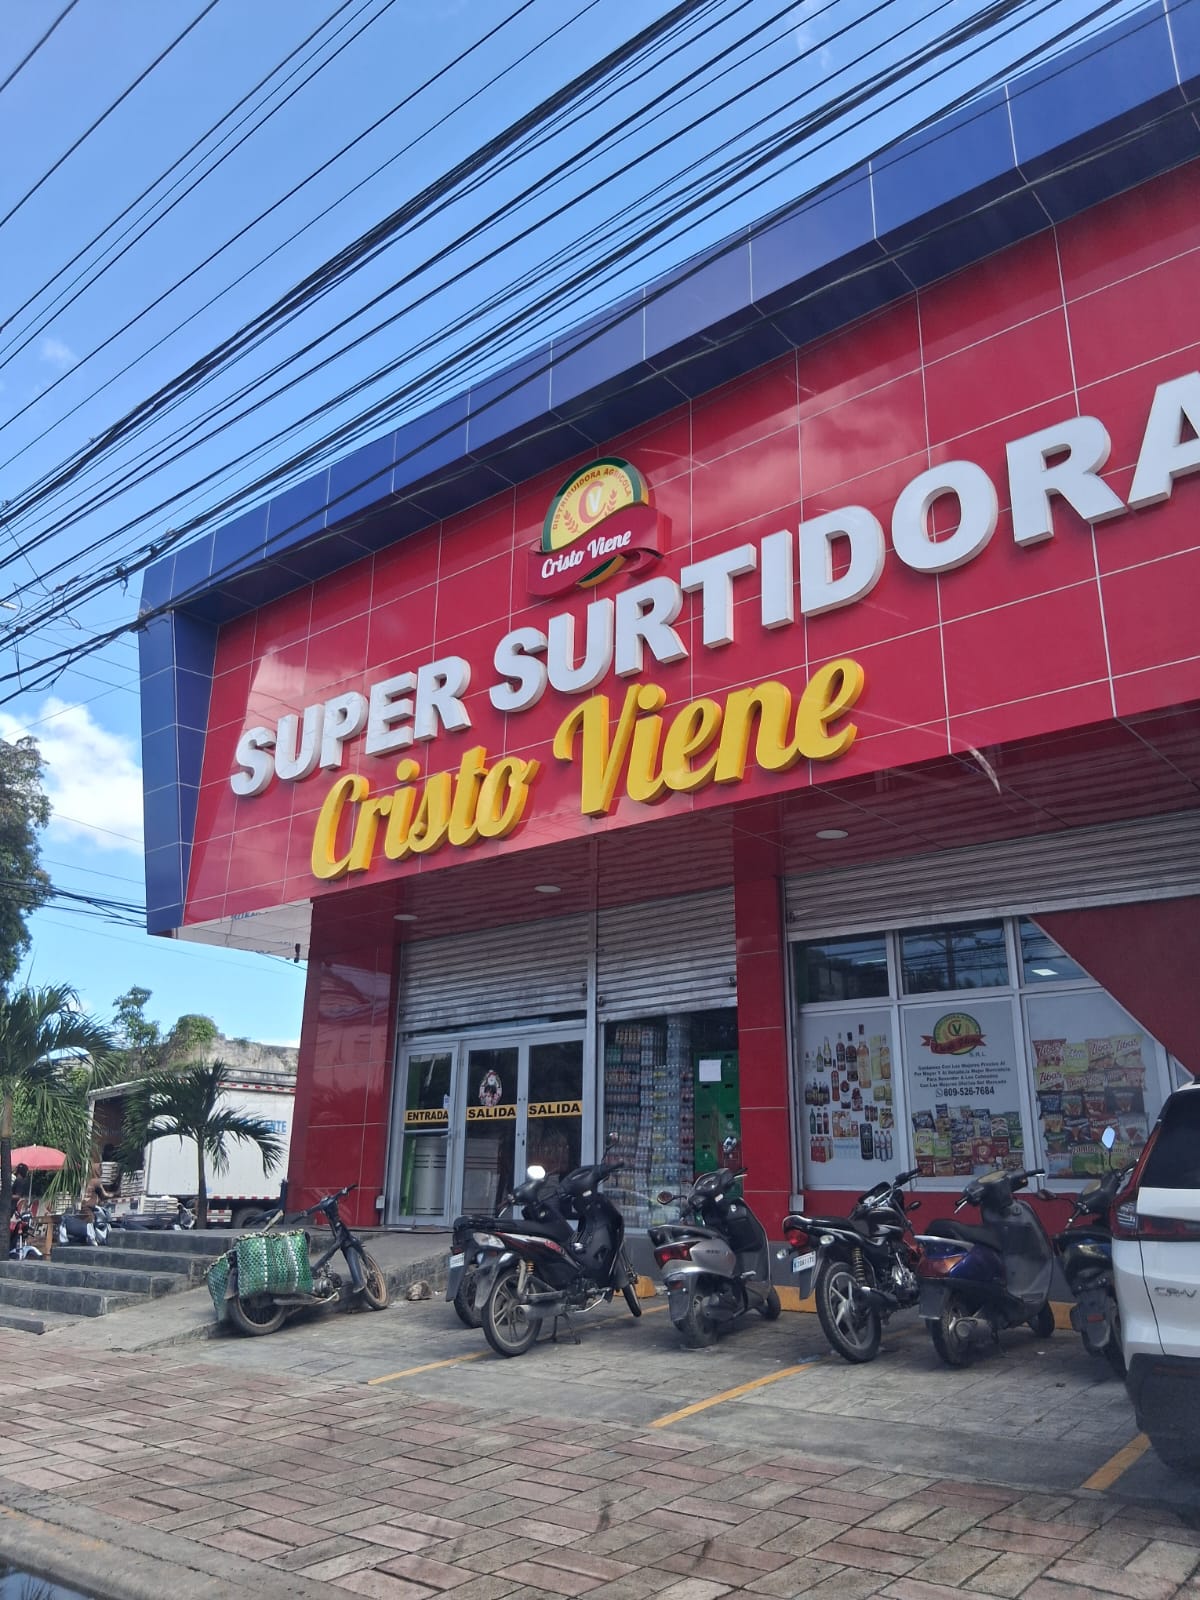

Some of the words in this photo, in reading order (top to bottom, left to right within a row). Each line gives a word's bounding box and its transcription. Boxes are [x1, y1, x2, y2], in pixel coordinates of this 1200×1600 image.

[552, 469, 601, 530] DISTRIBUIDORA
[541, 550, 585, 579] Cristo
[587, 530, 632, 559] Viene
[230, 655, 472, 797] SUPER
[488, 371, 1200, 712] SURTIDORA
[311, 745, 540, 880] Cristo
[552, 658, 866, 818] Viene
[407, 1110, 449, 1121] ENTRADA
[468, 1106, 517, 1119] SALIDA
[528, 1102, 581, 1116] SALIDA
